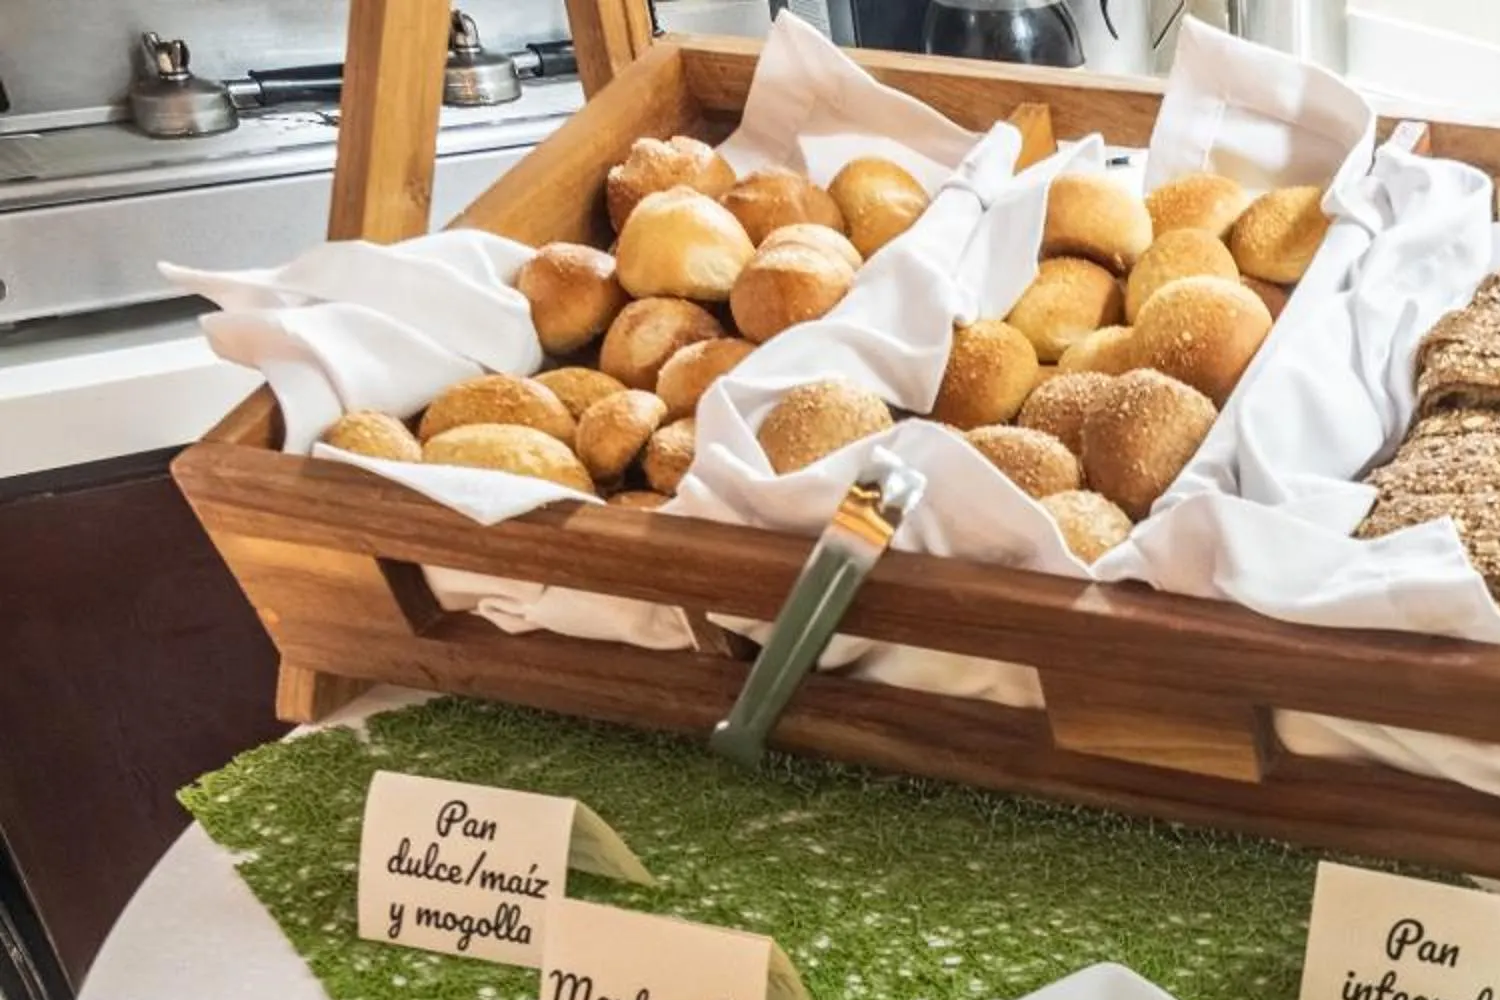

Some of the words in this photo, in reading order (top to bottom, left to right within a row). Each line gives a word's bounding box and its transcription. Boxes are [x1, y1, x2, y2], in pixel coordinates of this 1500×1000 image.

[436, 800, 496, 841] Pan
[387, 838, 549, 900] dulce/maíz
[388, 902, 406, 939] y
[415, 902, 532, 951] mogolla
[1385, 918, 1460, 967] Pan
